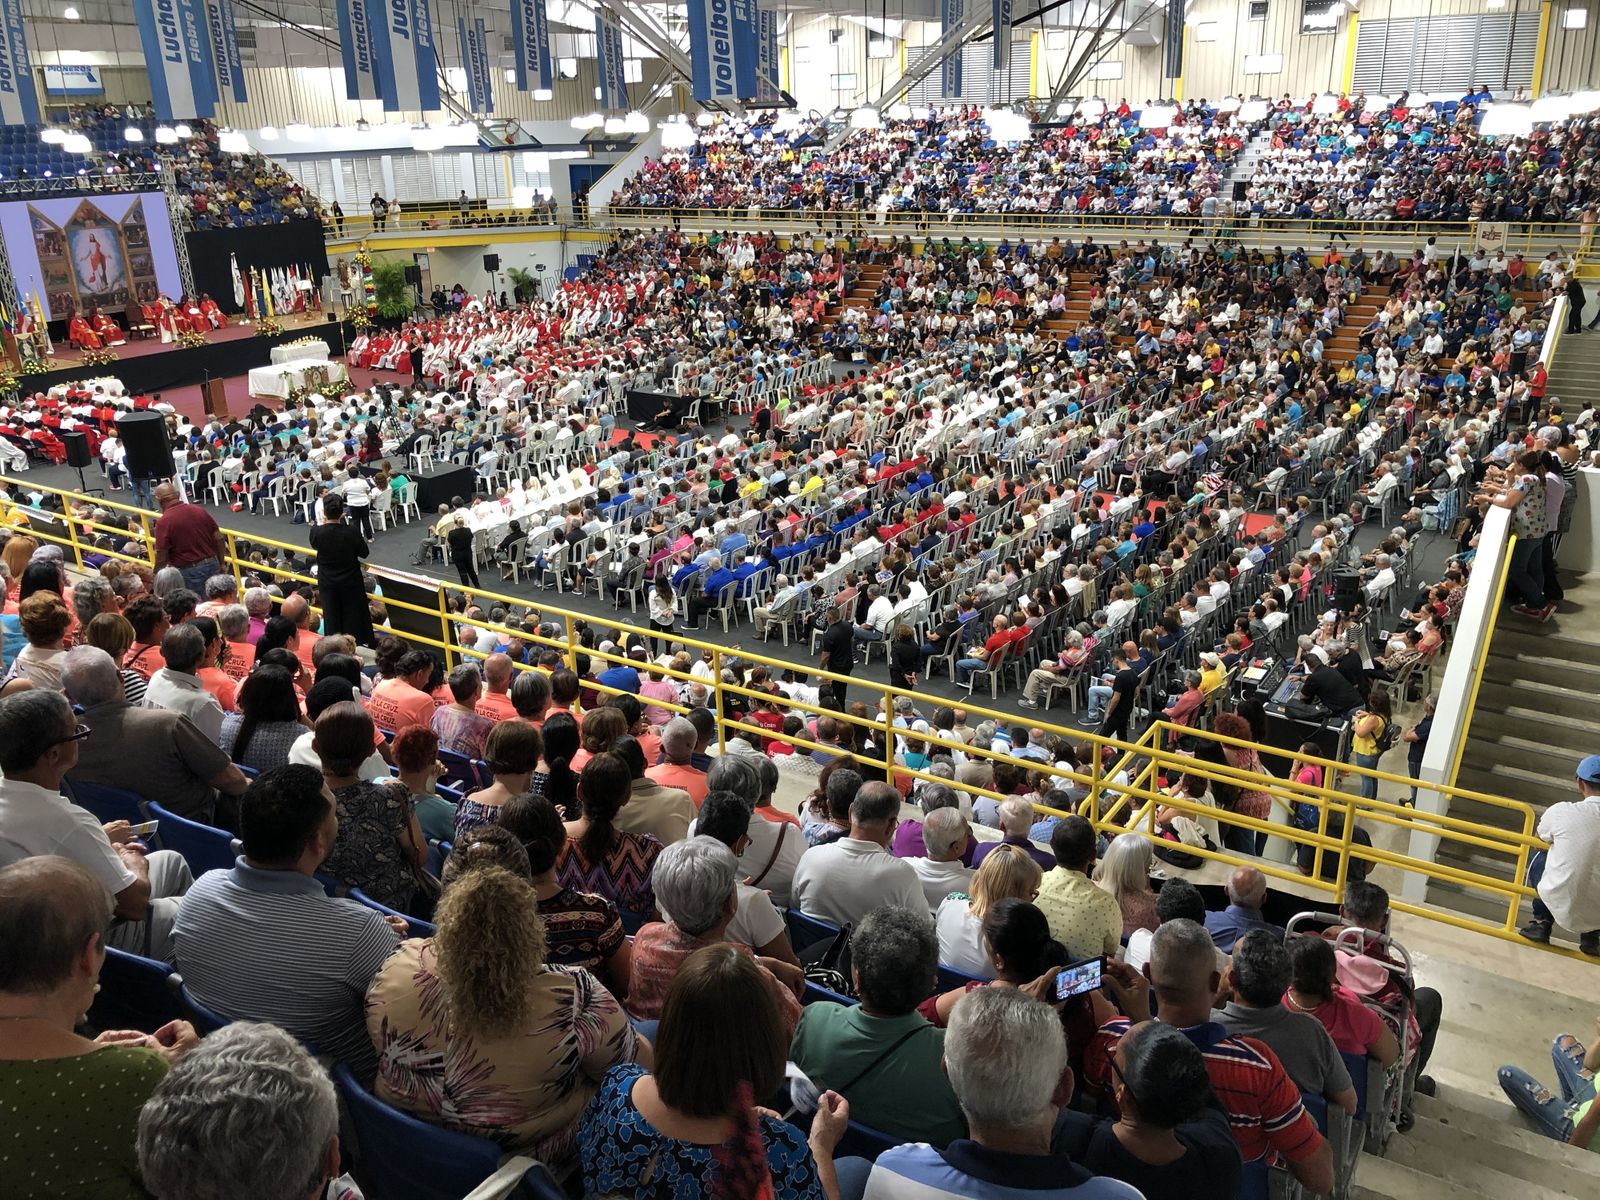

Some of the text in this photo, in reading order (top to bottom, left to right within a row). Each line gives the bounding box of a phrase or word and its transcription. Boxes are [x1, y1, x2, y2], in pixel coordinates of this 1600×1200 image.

[13, 32, 29, 76] Fiebre
[158, 0, 183, 63] Lucha
[185, 11, 201, 63] Fiebre
[208, 4, 230, 86] Baloncesto
[351, 0, 370, 74] Natación
[468, 29, 485, 105] Taekwondo
